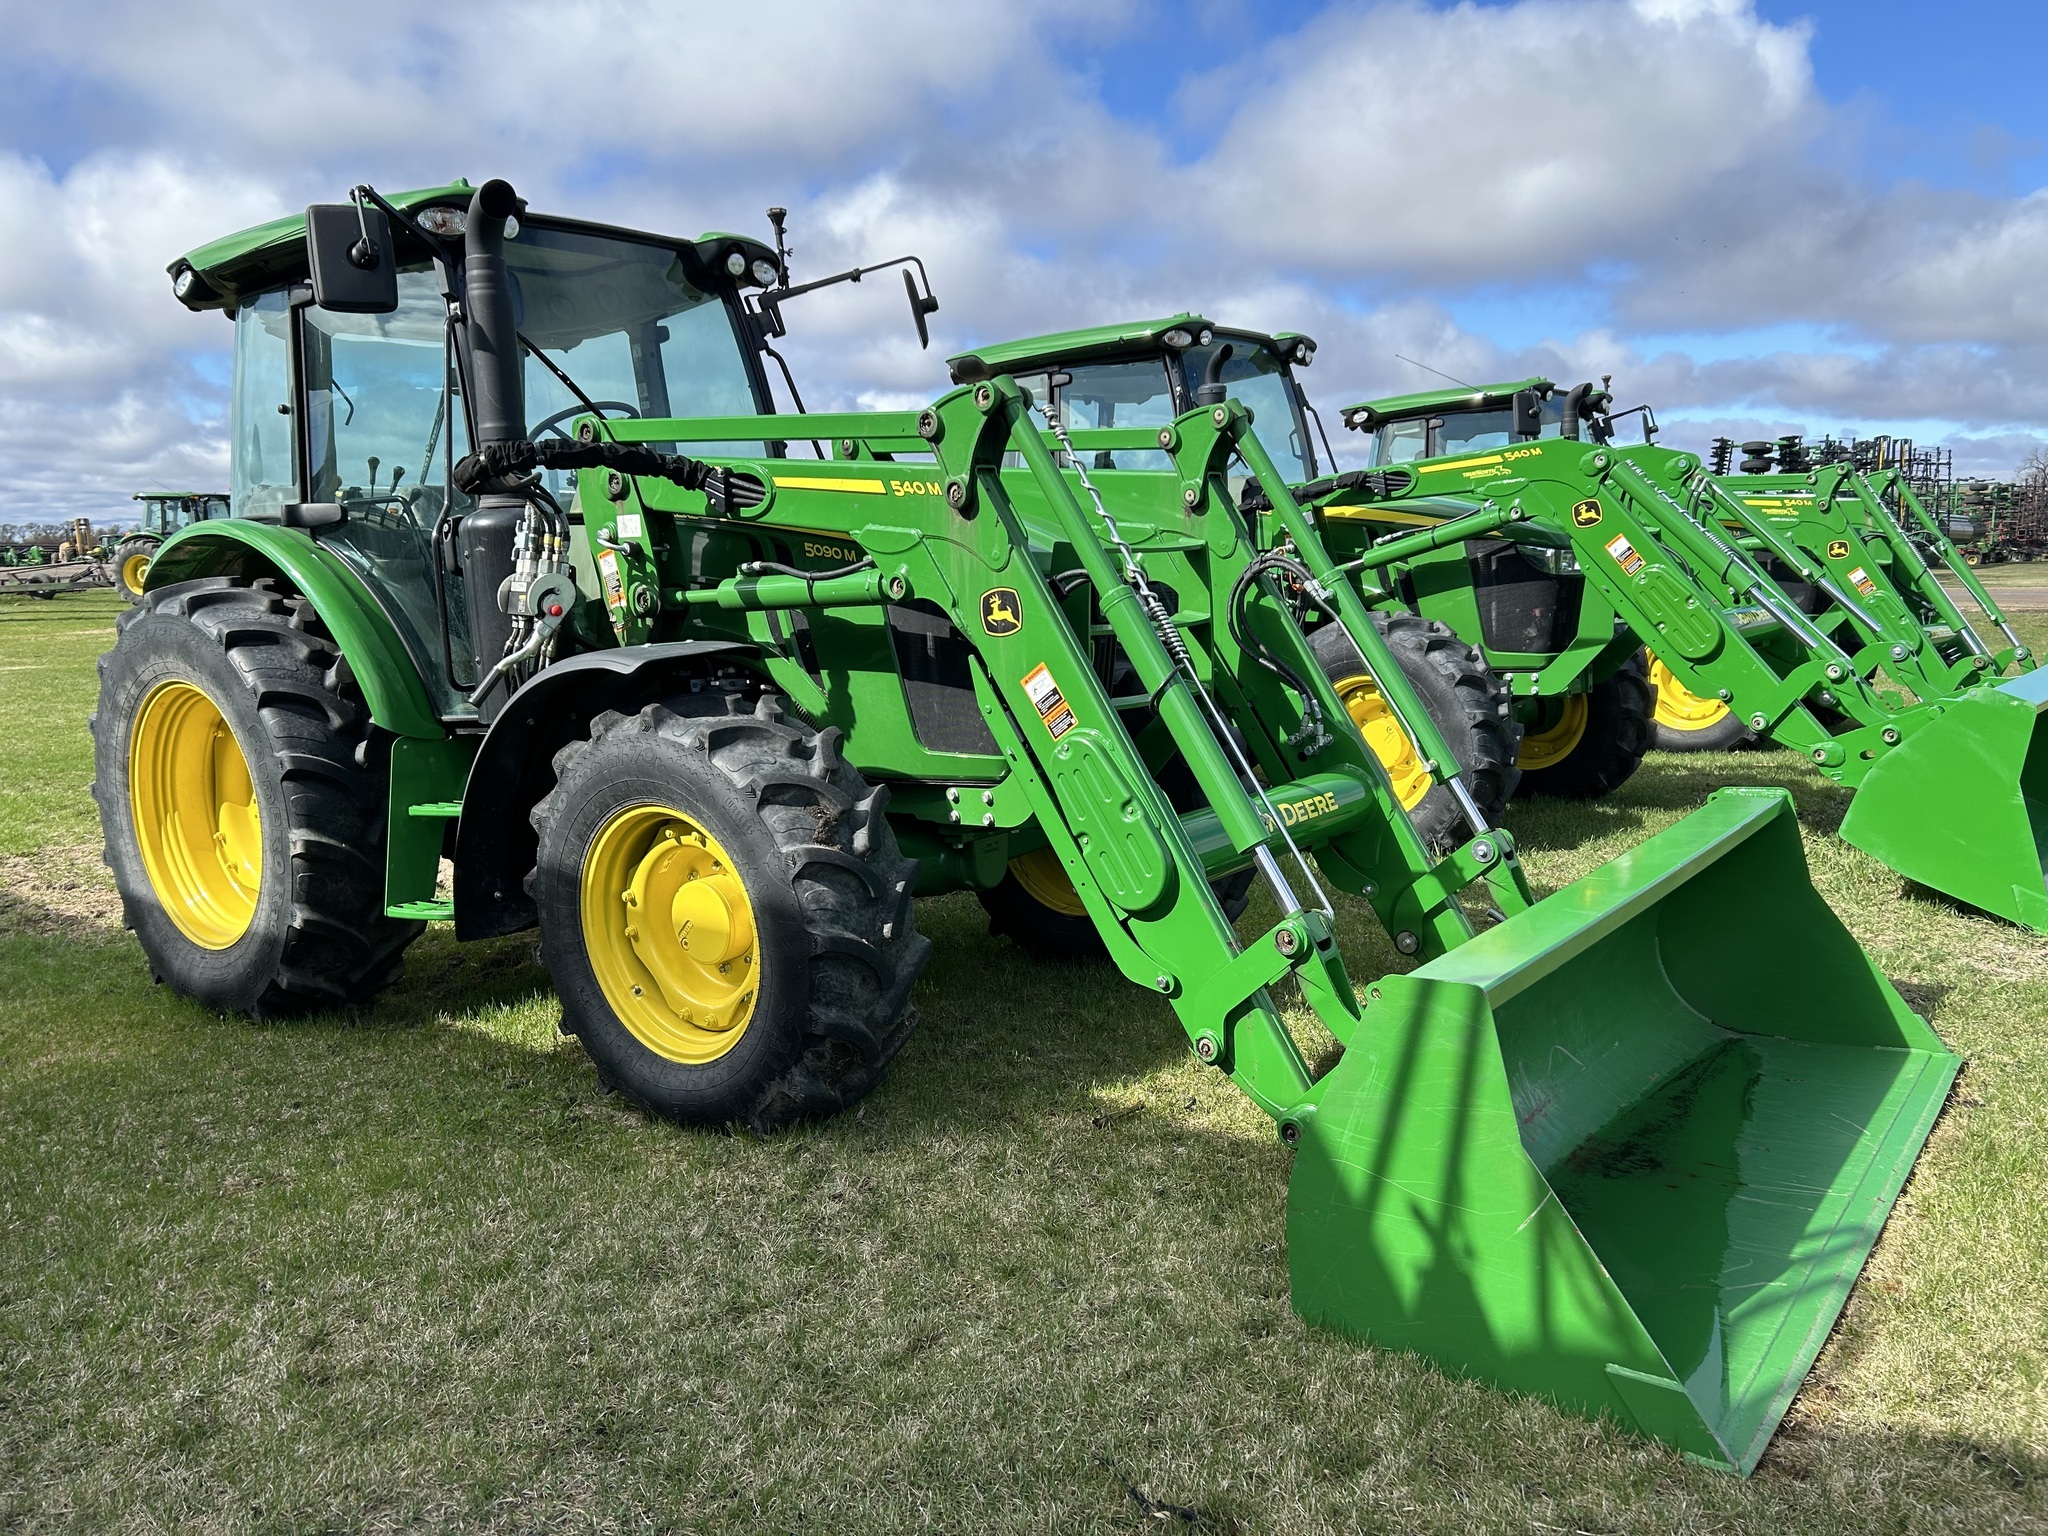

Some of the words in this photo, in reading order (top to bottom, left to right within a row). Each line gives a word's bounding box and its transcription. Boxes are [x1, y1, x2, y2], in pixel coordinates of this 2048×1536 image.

[1503, 450, 1530, 461] 540
[1530, 447, 1543, 456] M
[890, 480, 926, 497] 540
[926, 481, 943, 496] M
[1783, 499, 1804, 507] 540
[804, 542, 842, 559] 5090
[843, 548, 857, 562] M
[1277, 791, 1339, 827] DEERE
